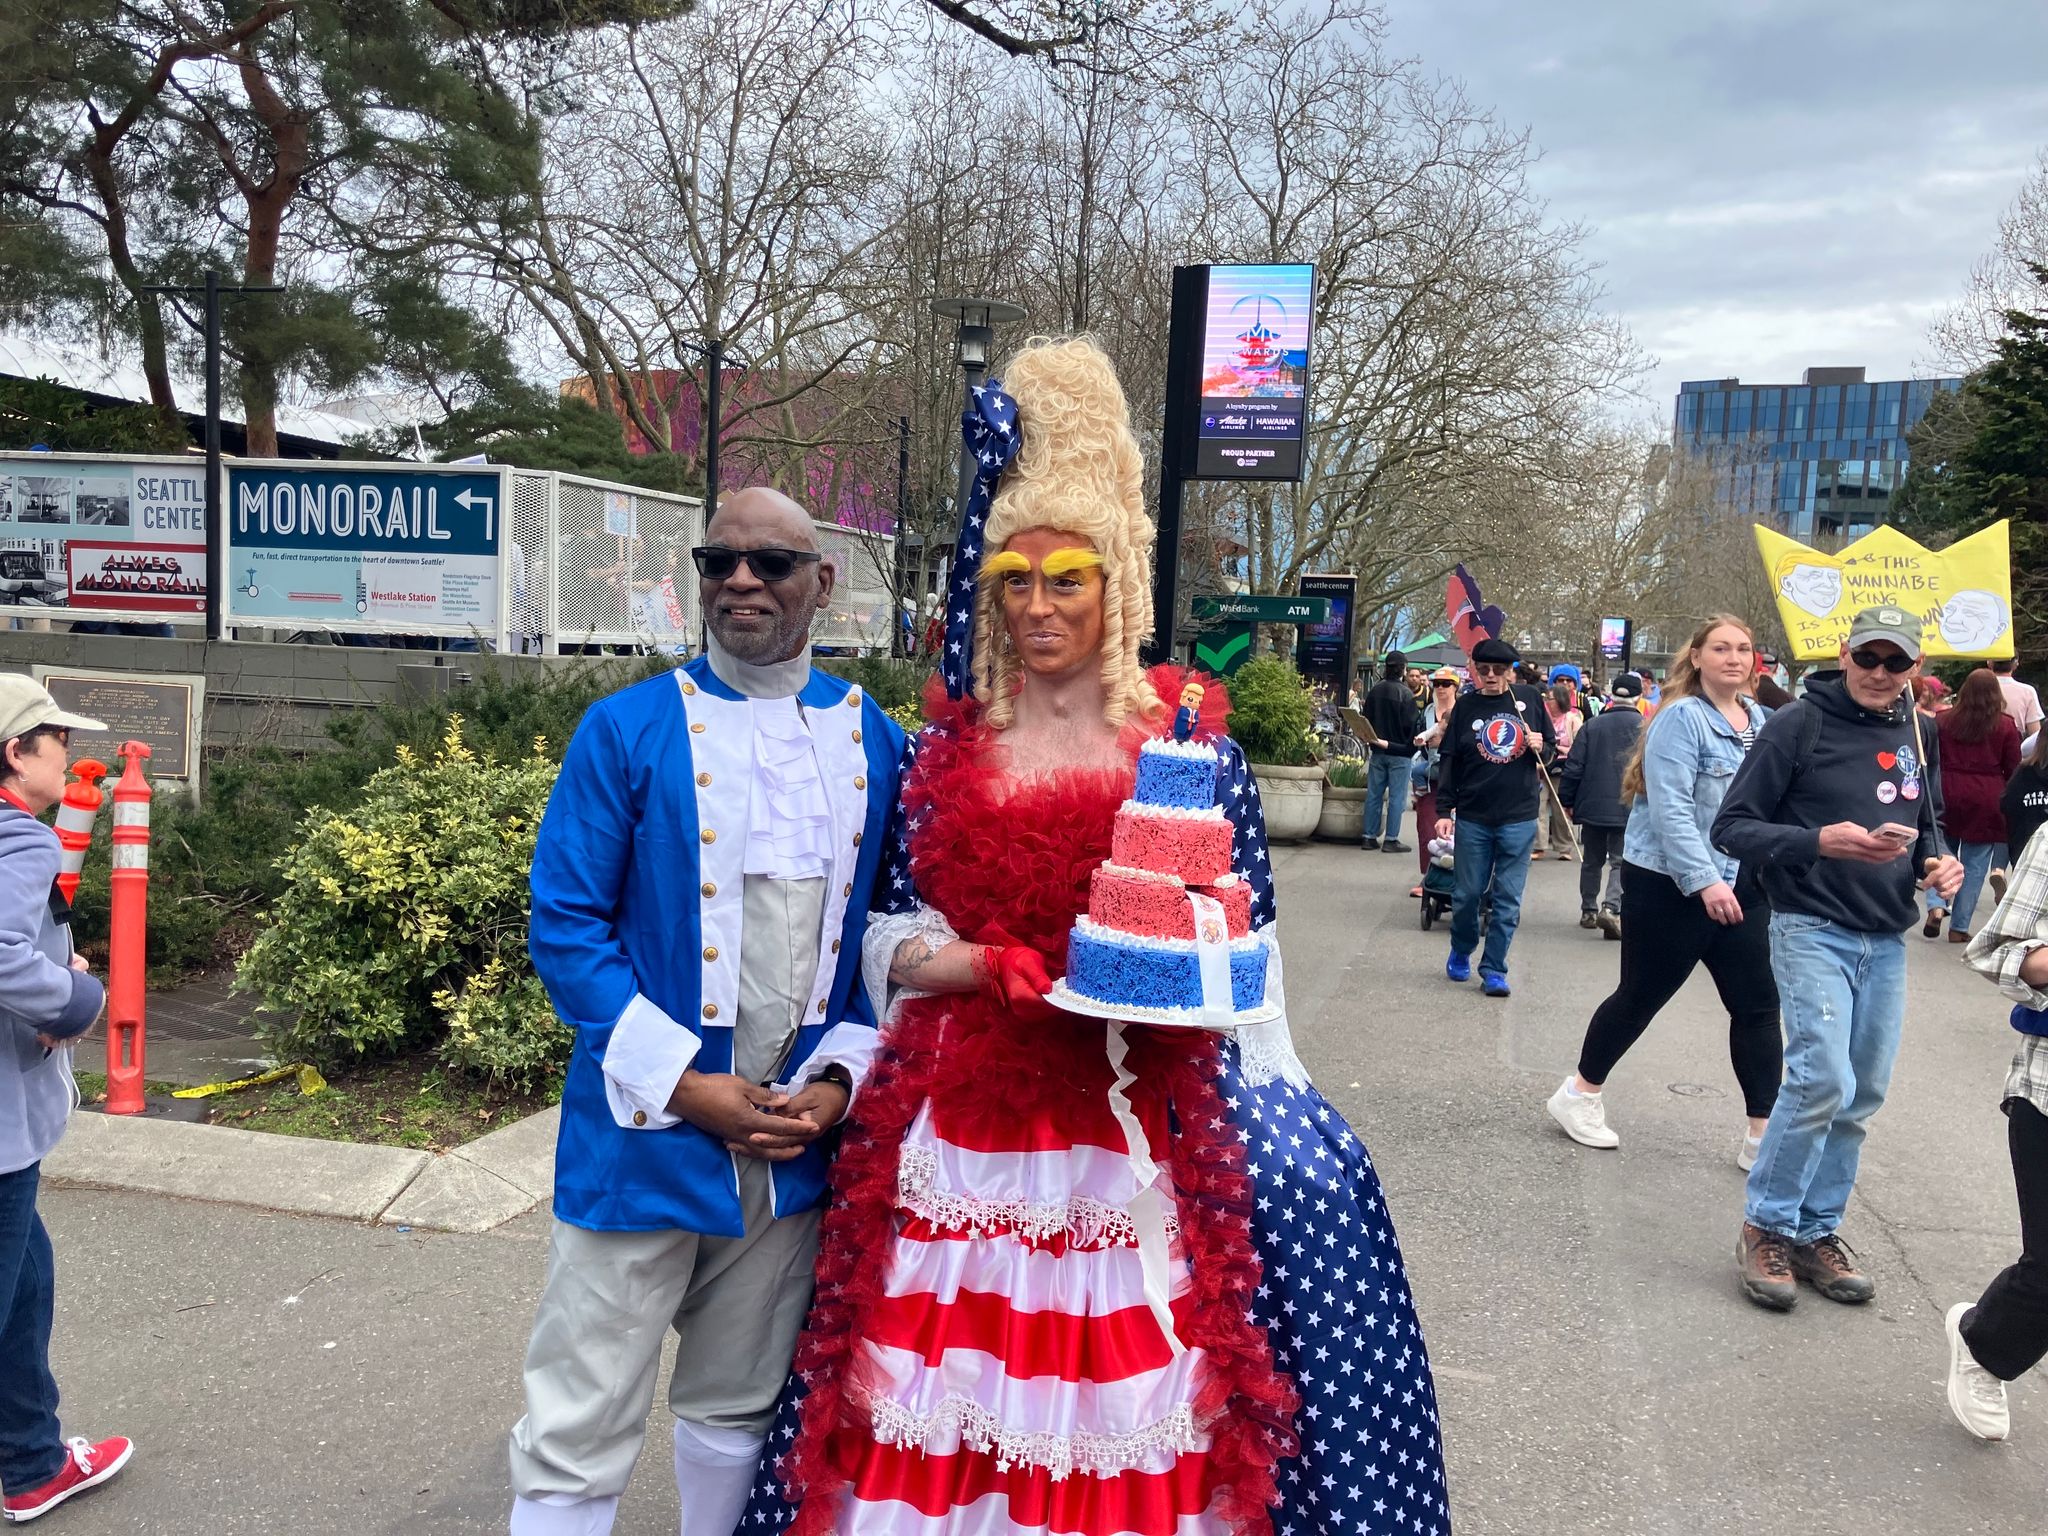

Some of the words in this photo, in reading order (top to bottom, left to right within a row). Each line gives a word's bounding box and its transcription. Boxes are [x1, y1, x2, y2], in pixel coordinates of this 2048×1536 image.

[1219, 416, 1247, 425] Alaska
[138, 478, 206, 502] SEATTL
[144, 506, 206, 530] CENTE
[240, 482, 451, 540] MONORAIL
[106, 554, 178, 570] ALWEG
[252, 552, 265, 560] Fun,
[266, 552, 279, 560] fast,
[299, 554, 343, 563] transportation
[388, 557, 419, 565] downtown
[1878, 556, 1920, 569] THIS
[80, 573, 207, 593] MONORAIL
[1846, 575, 1940, 590] WANNABE
[371, 592, 406, 600] Westlake
[409, 592, 436, 602] Station
[1852, 591, 1897, 605] KING
[1288, 606, 1310, 615] ATM
[1796, 621, 1820, 631] IS
[1832, 615, 1856, 626] TH
[1920, 598, 1944, 626] WN
[1801, 632, 1849, 650] DESP
